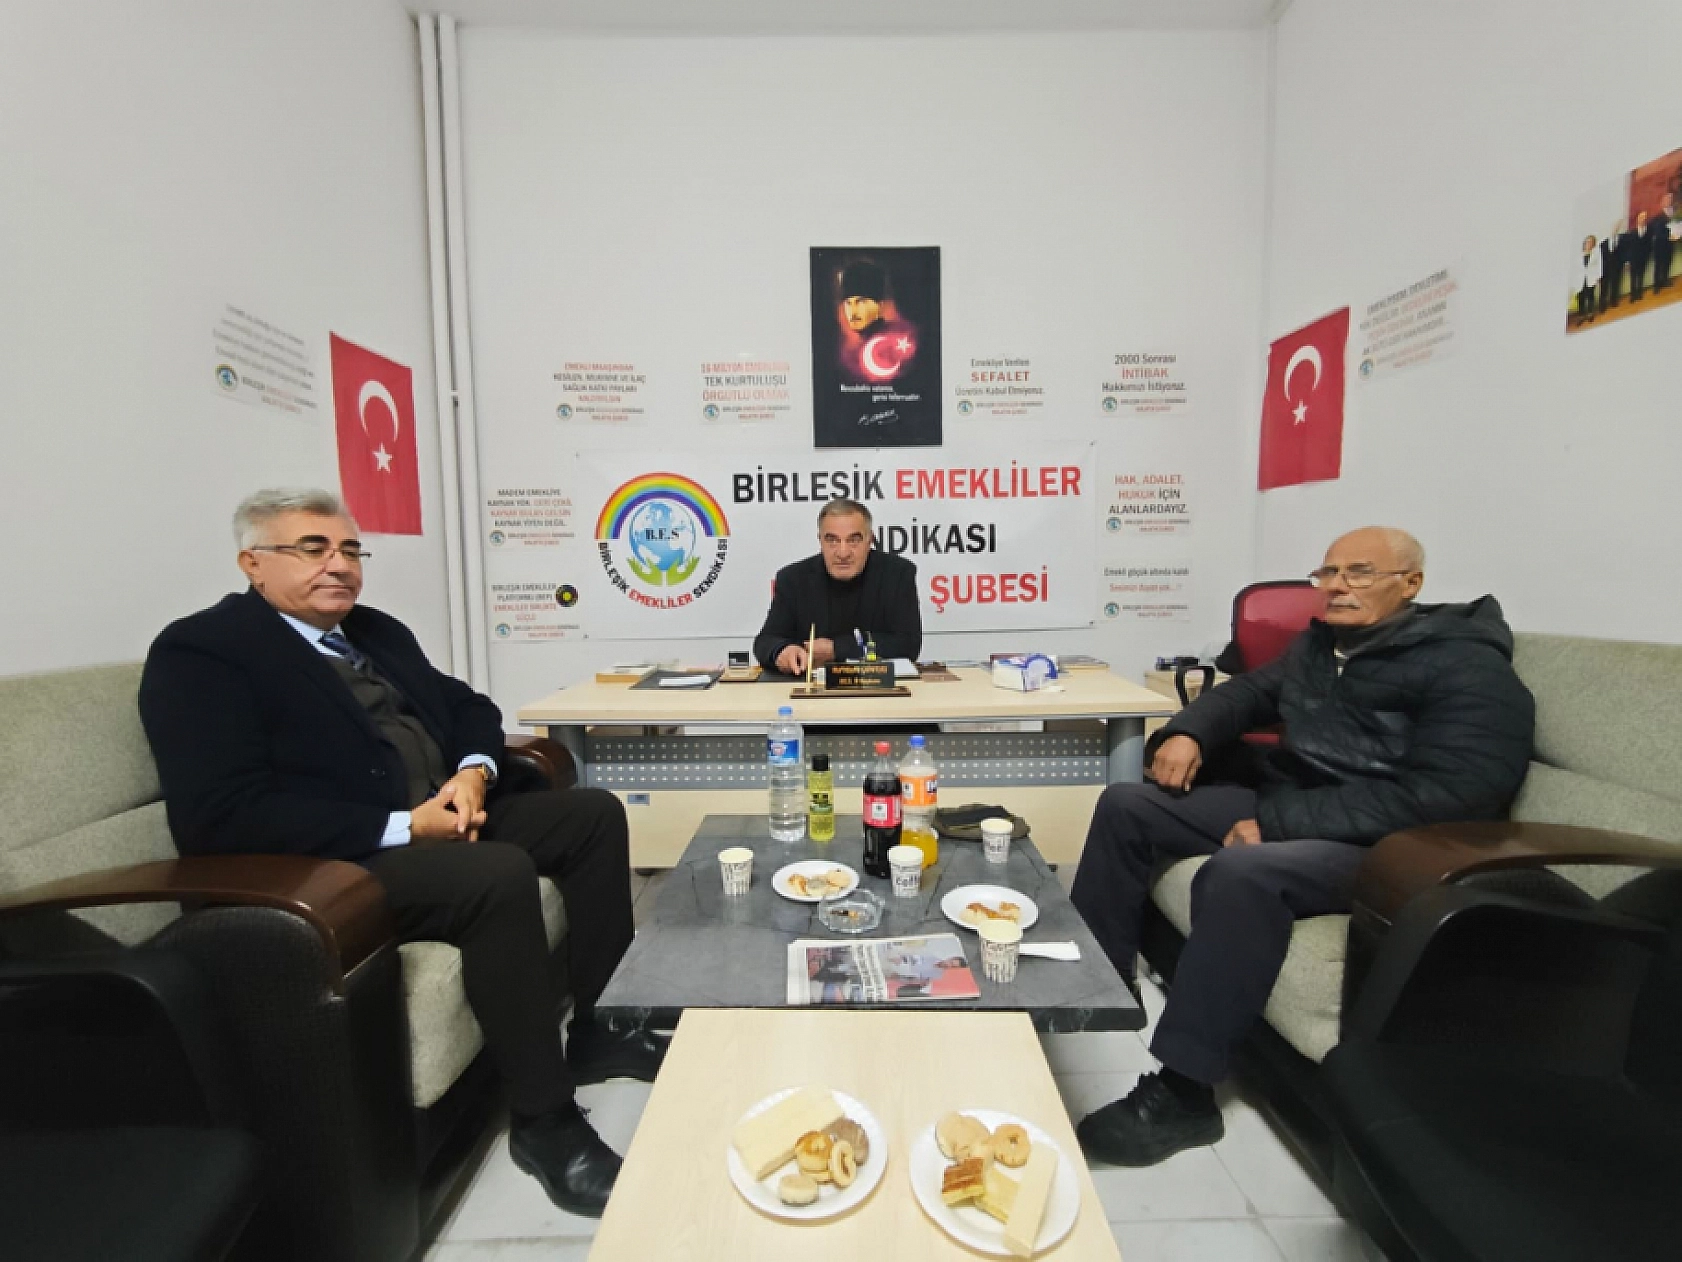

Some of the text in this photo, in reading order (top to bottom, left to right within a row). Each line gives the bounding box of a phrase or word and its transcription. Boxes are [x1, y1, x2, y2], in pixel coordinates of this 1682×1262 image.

[971, 371, 1030, 382] SEFALET
[1115, 354, 1139, 364] 2000
[896, 460, 1081, 499] EMEKLİLER
[872, 517, 997, 554] NDİKASI
[930, 565, 1048, 613] ŞUBESİ
